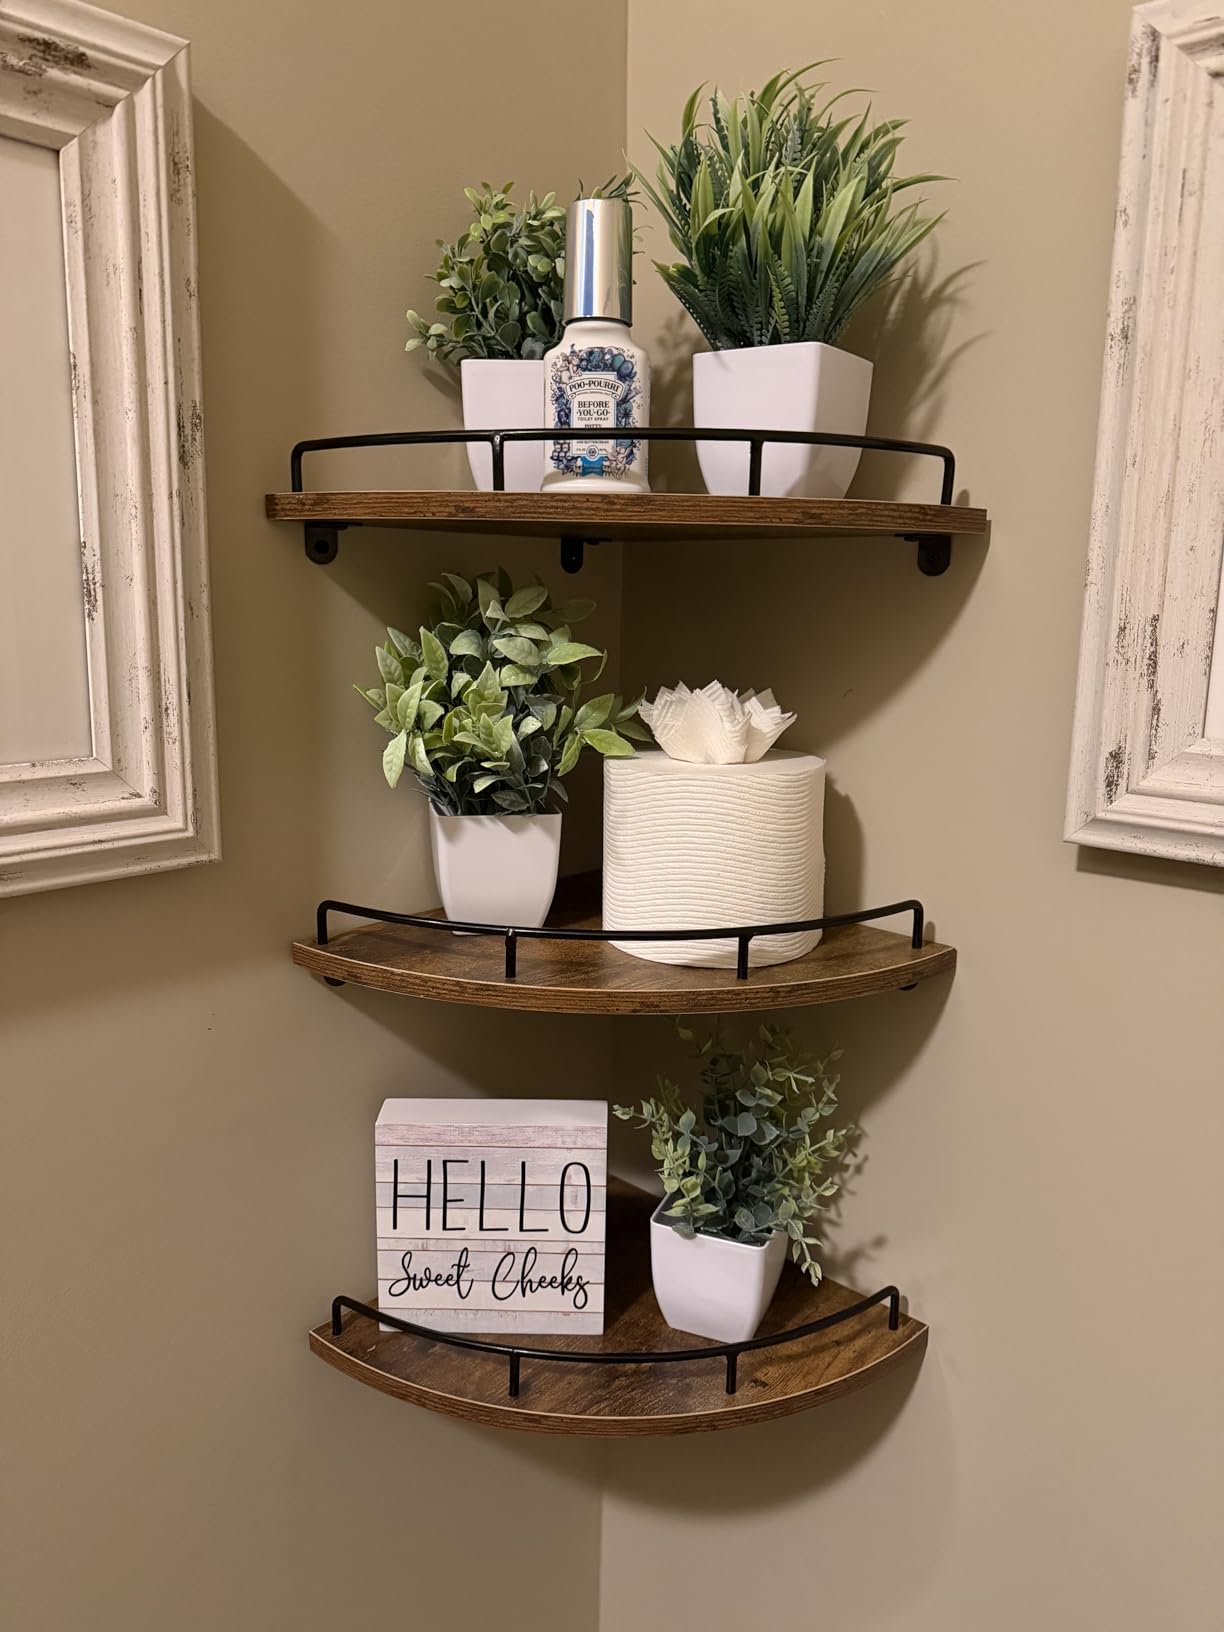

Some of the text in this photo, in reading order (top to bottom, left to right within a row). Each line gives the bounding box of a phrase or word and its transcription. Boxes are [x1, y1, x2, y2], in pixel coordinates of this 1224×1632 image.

[569, 379, 620, 392] POO-POURRI
[577, 400, 610, 409] BEFORE
[392, 1158, 592, 1235] HELLO
[388, 1246, 590, 1310] Sweet Cheeks
